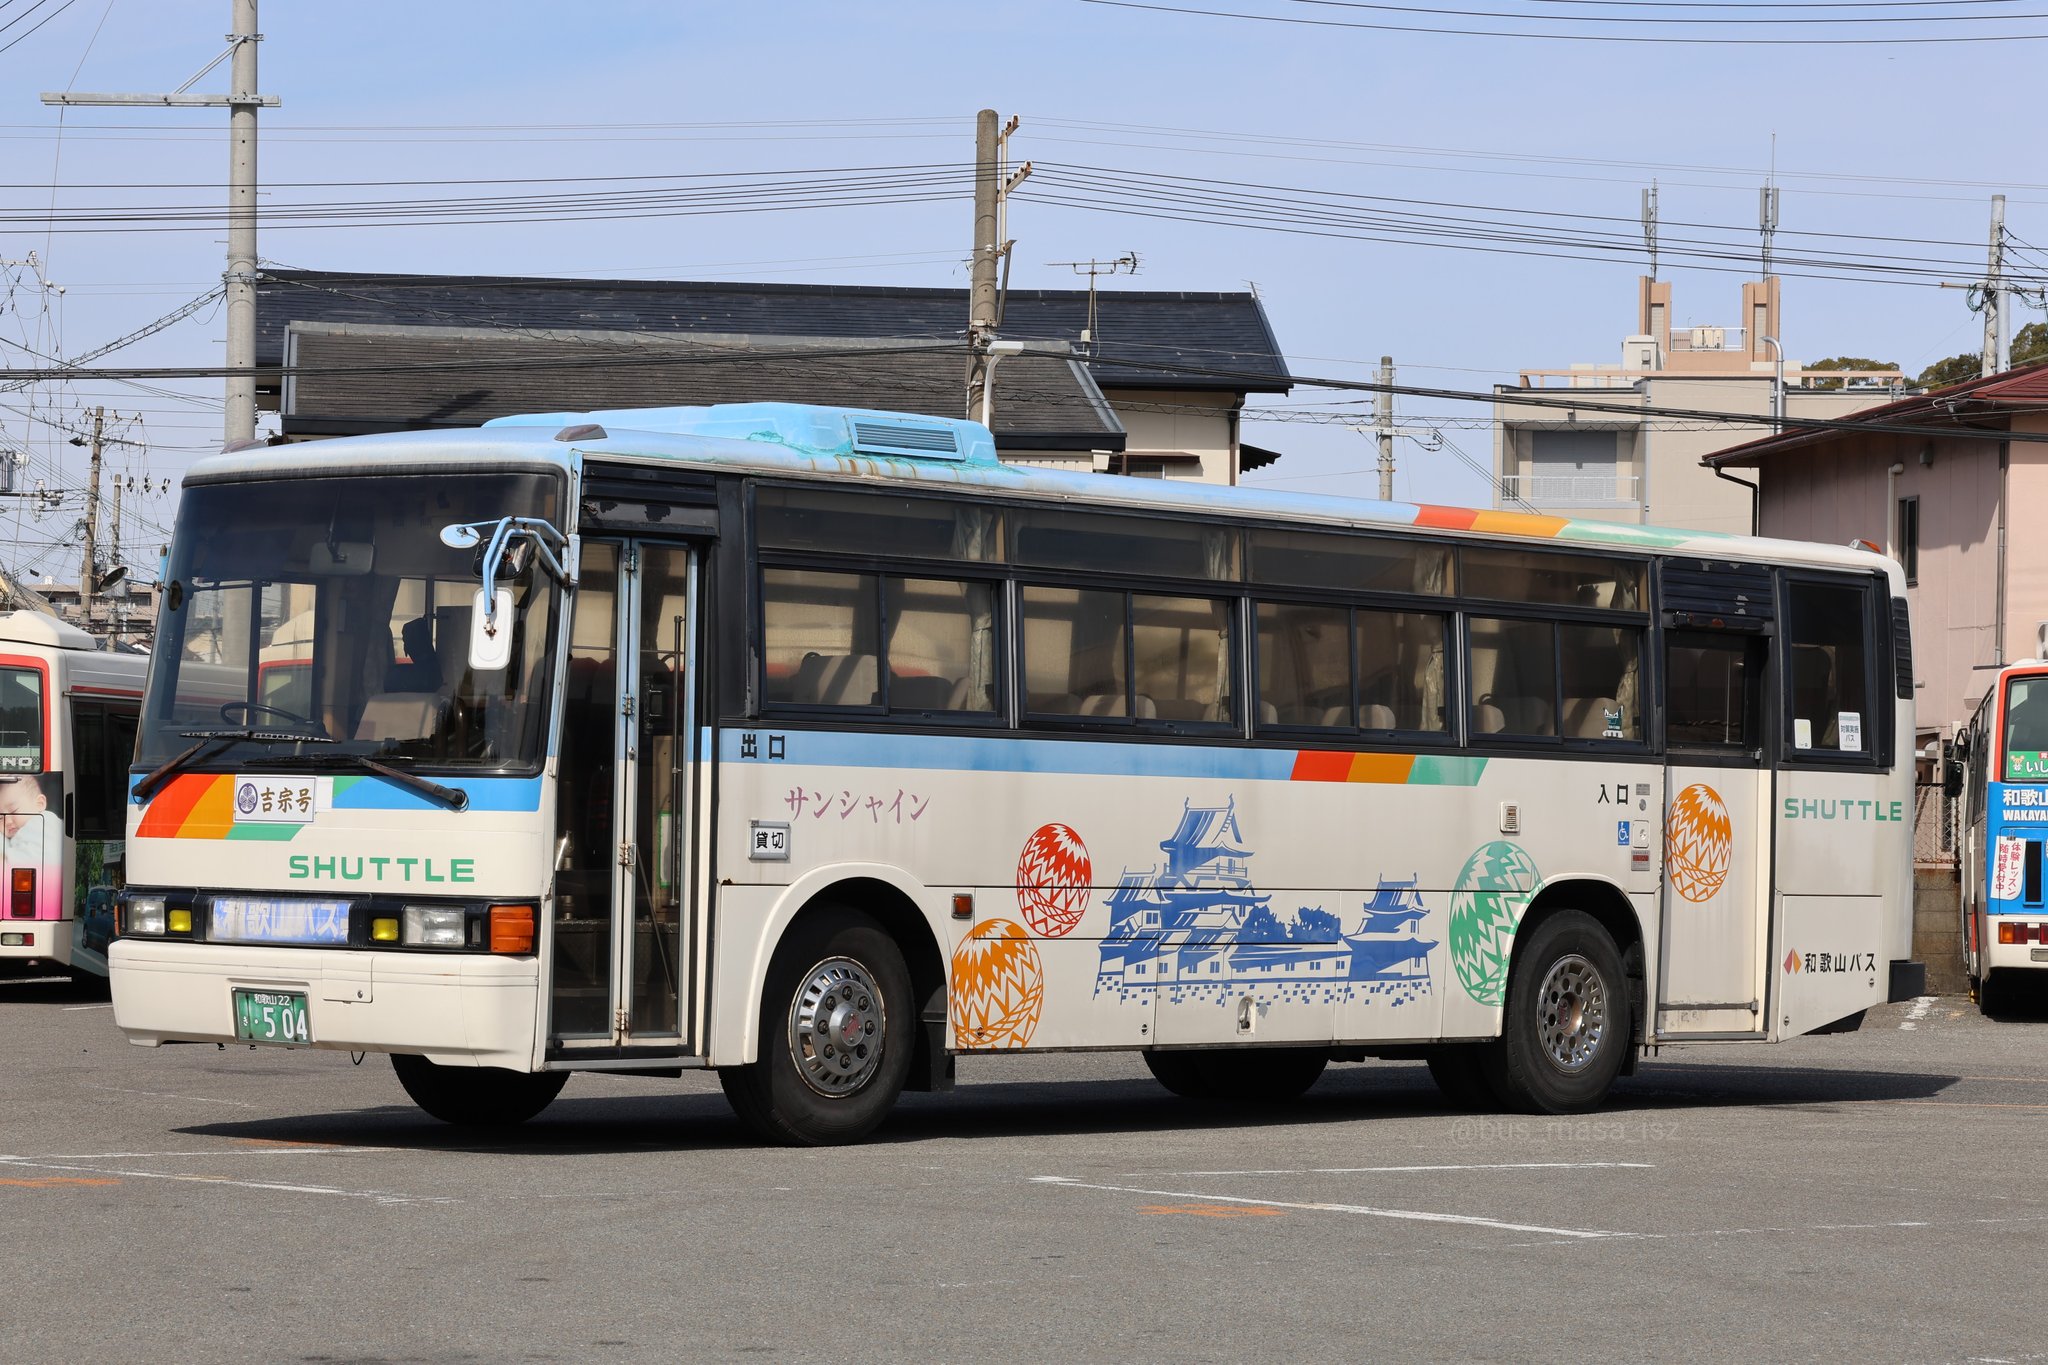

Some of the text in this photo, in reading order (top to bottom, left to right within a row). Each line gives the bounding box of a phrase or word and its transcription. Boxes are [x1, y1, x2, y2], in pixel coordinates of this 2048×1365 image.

[741, 733, 785, 759] 出口
[260, 786, 312, 813] 吉宗号
[784, 786, 931, 824] サンシャイン
[1598, 783, 1629, 805] 入口
[1784, 797, 1902, 821] SHUTTLE
[2003, 809, 2048, 821] WAKAYA
[756, 831, 784, 849] 貸切
[289, 855, 475, 882] SHUTTLE
[2008, 842, 2021, 896] 体験レッスン
[1804, 952, 1876, 974] 和歌山バス
